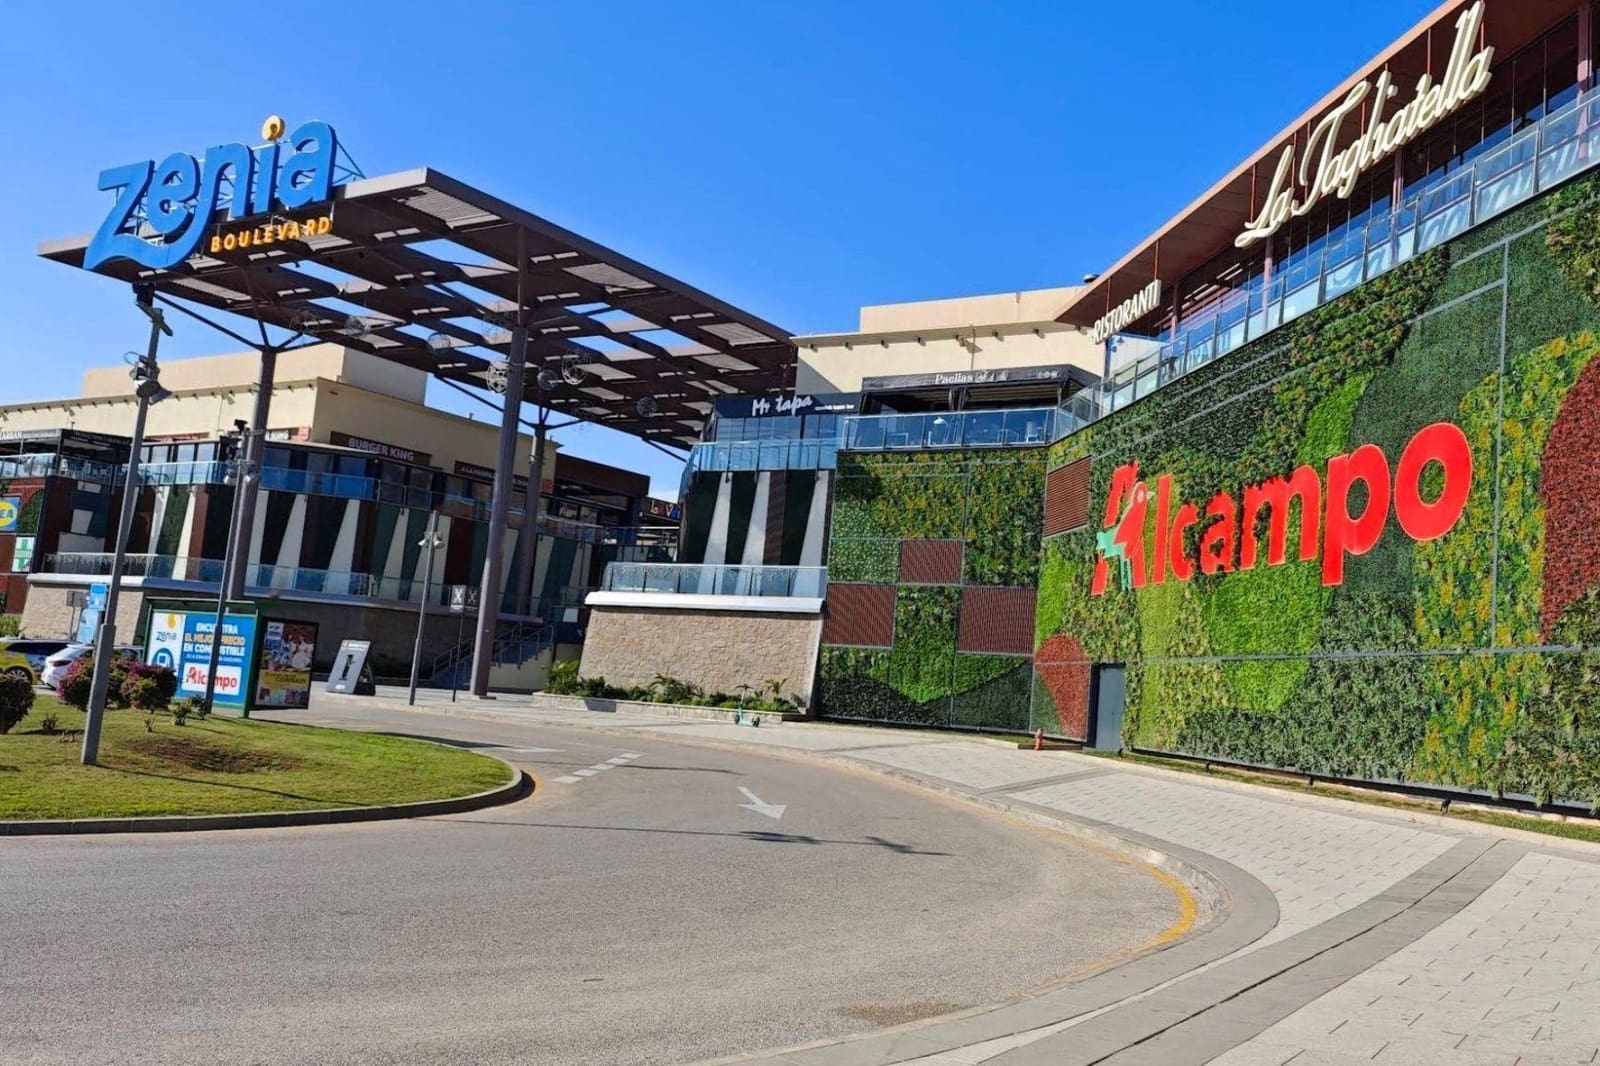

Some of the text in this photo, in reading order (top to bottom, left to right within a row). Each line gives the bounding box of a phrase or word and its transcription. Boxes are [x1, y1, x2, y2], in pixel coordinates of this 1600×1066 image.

[1235, 145, 1295, 248] La
[210, 216, 333, 252] BOULEVARD
[1092, 279, 1162, 345] RISTORANTI
[775, 395, 813, 416] tapa
[348, 437, 415, 461] BURGER KING
[1091, 422, 1473, 596] Alcampo
[185, 667, 238, 690] Alcmpo
